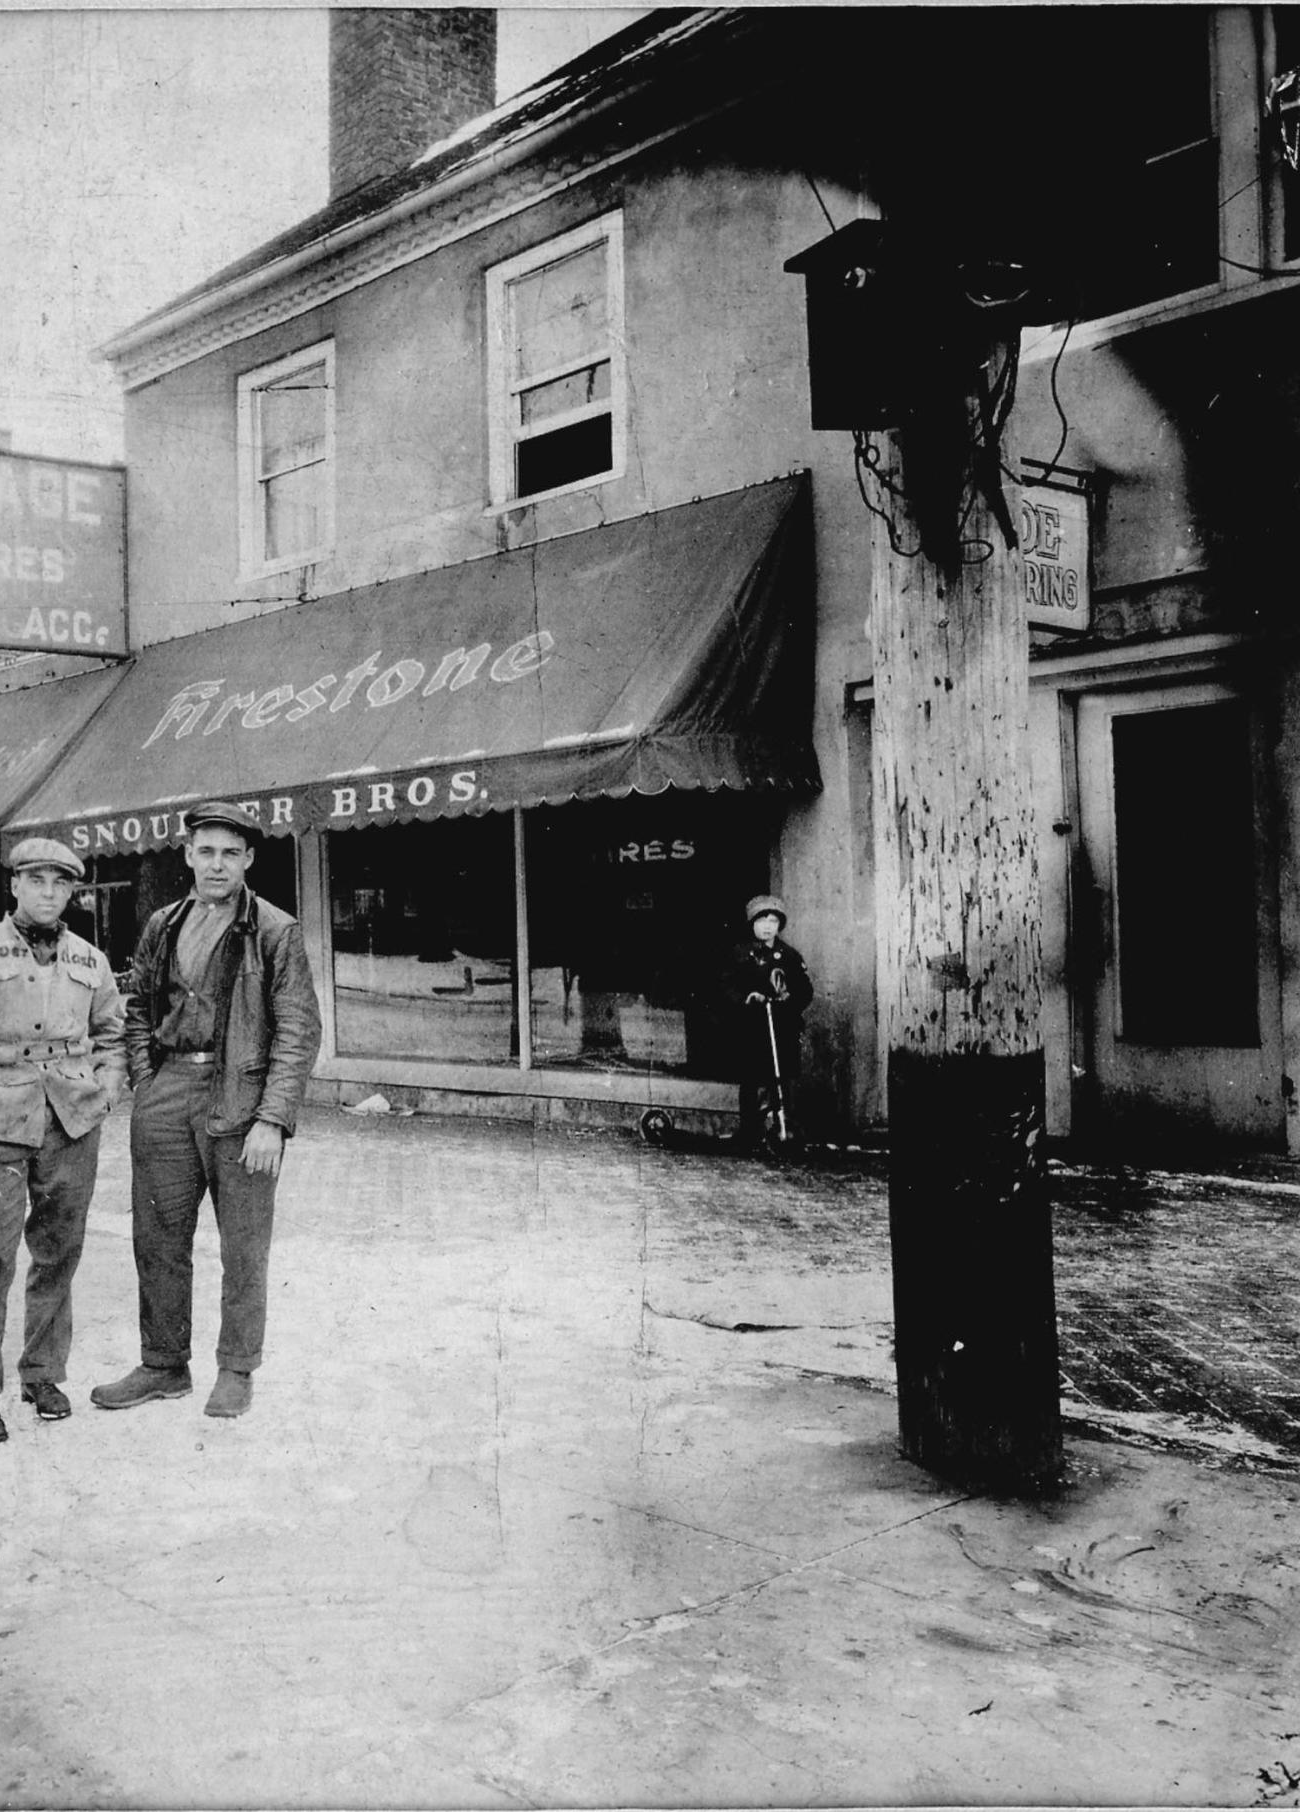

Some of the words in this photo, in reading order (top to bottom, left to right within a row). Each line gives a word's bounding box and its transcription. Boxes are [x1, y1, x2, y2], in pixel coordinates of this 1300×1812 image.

[1024, 560, 1078, 610] RING
[141, 630, 555, 749] Firestone
[73, 796, 294, 850] SNOUER
[331, 770, 489, 818] BROS.
